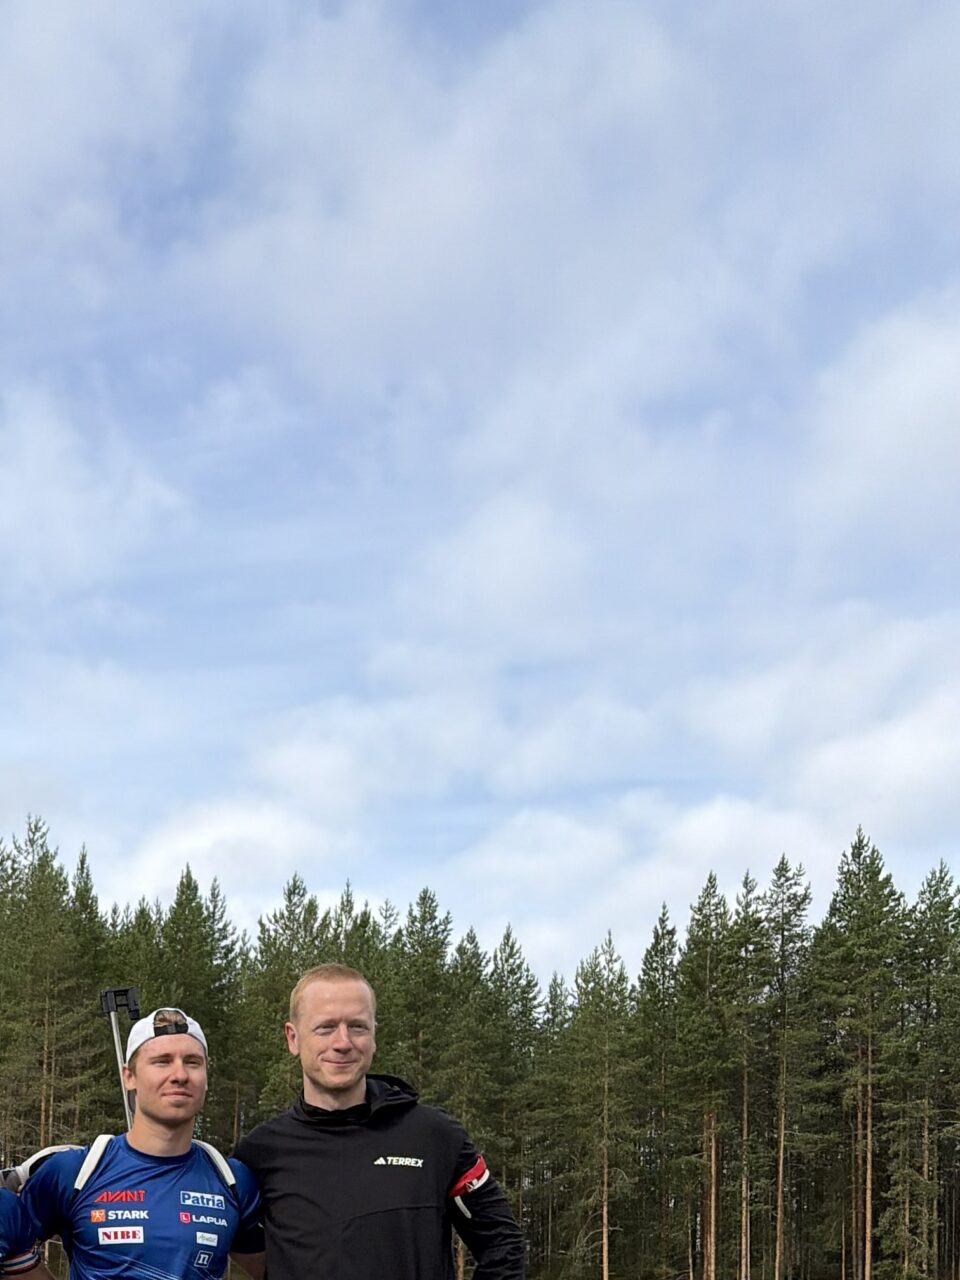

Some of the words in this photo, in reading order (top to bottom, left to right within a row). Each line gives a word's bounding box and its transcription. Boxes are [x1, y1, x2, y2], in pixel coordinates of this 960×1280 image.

[387, 1157, 424, 1168] TERREX
[93, 1190, 145, 1203] AVANT
[181, 1193, 224, 1209] Patria
[107, 1210, 149, 1220] STARK
[192, 1214, 228, 1227] LAPUA
[102, 1230, 141, 1241] NIBE
